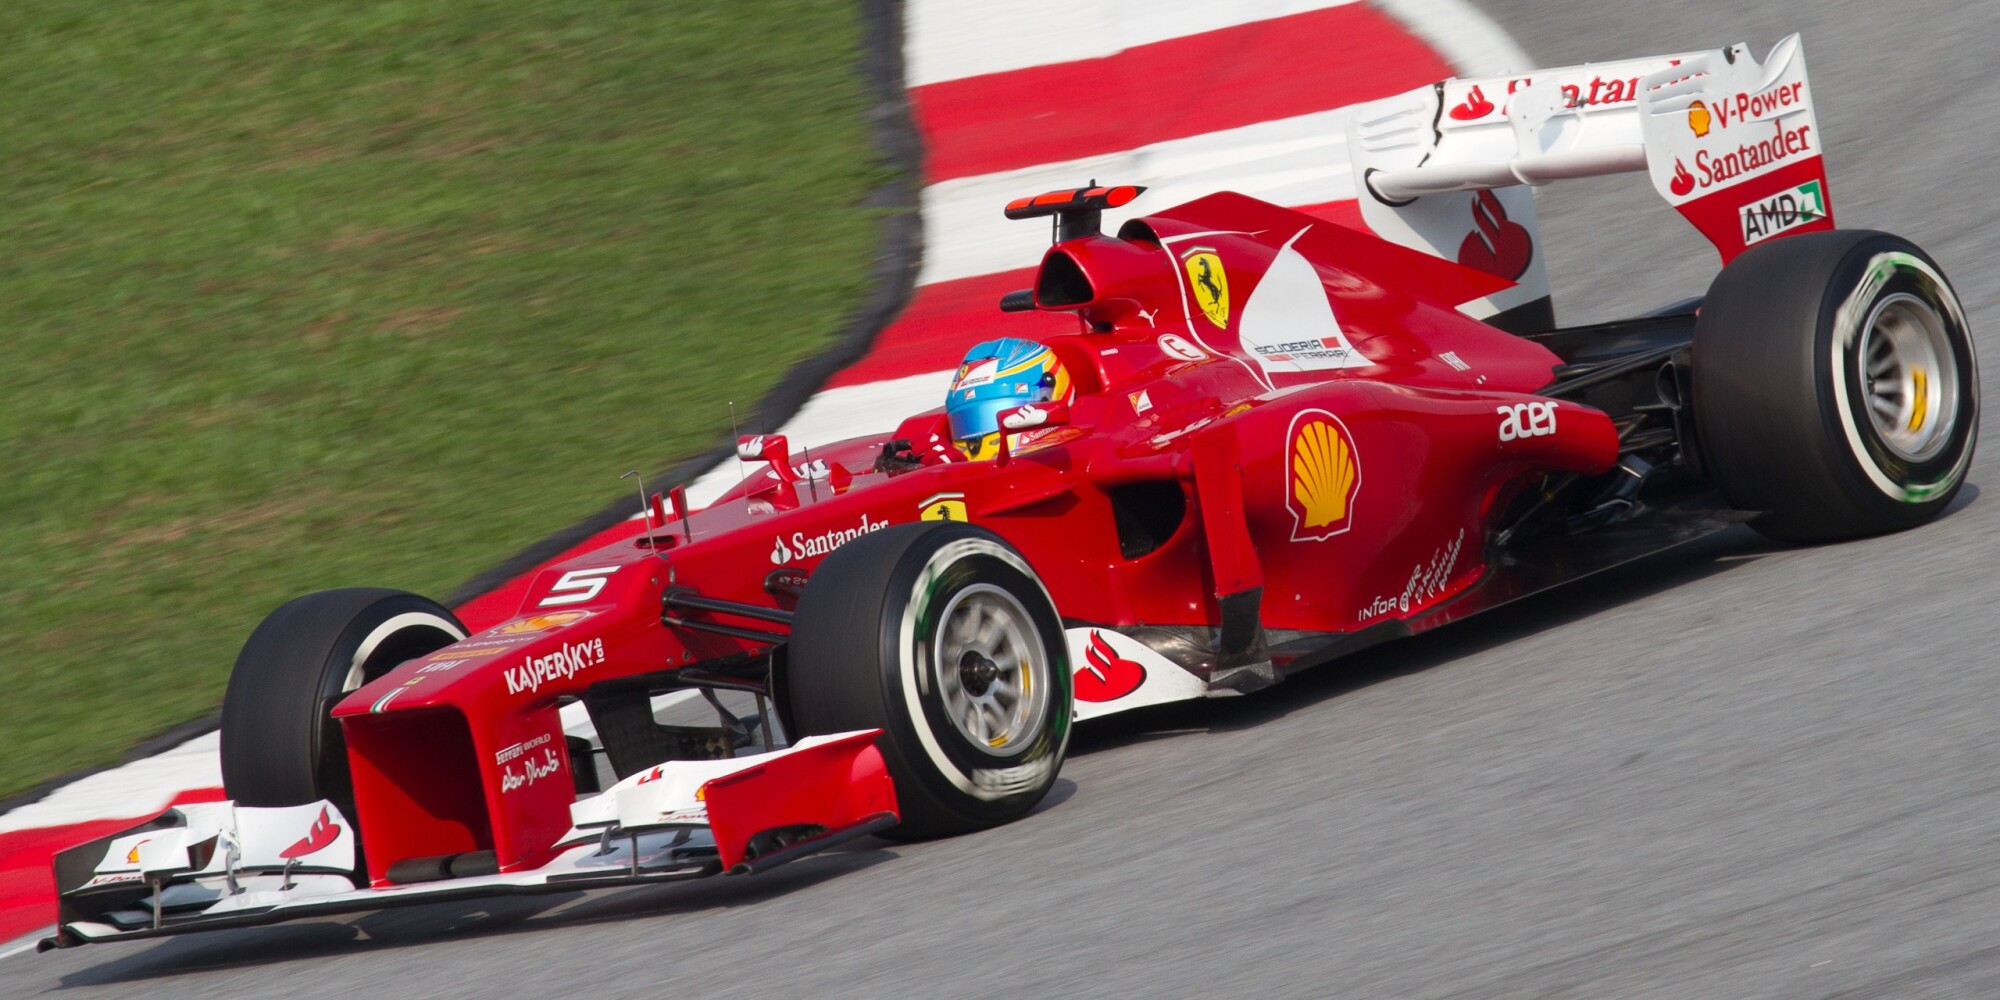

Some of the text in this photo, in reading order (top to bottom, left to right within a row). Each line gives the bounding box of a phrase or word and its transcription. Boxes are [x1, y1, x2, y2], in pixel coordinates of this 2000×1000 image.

[1712, 81, 1802, 129] V-Power
[1695, 118, 1811, 188] Santander
[1746, 193, 1797, 242] AMD
[1255, 339, 1323, 354] SCUDERIA
[1291, 350, 1348, 360] FERRARI
[1497, 401, 1559, 442] acer
[538, 565, 622, 608] 5
[504, 640, 594, 695] KASPERSKY
[502, 748, 560, 793] Abu Dhabi
